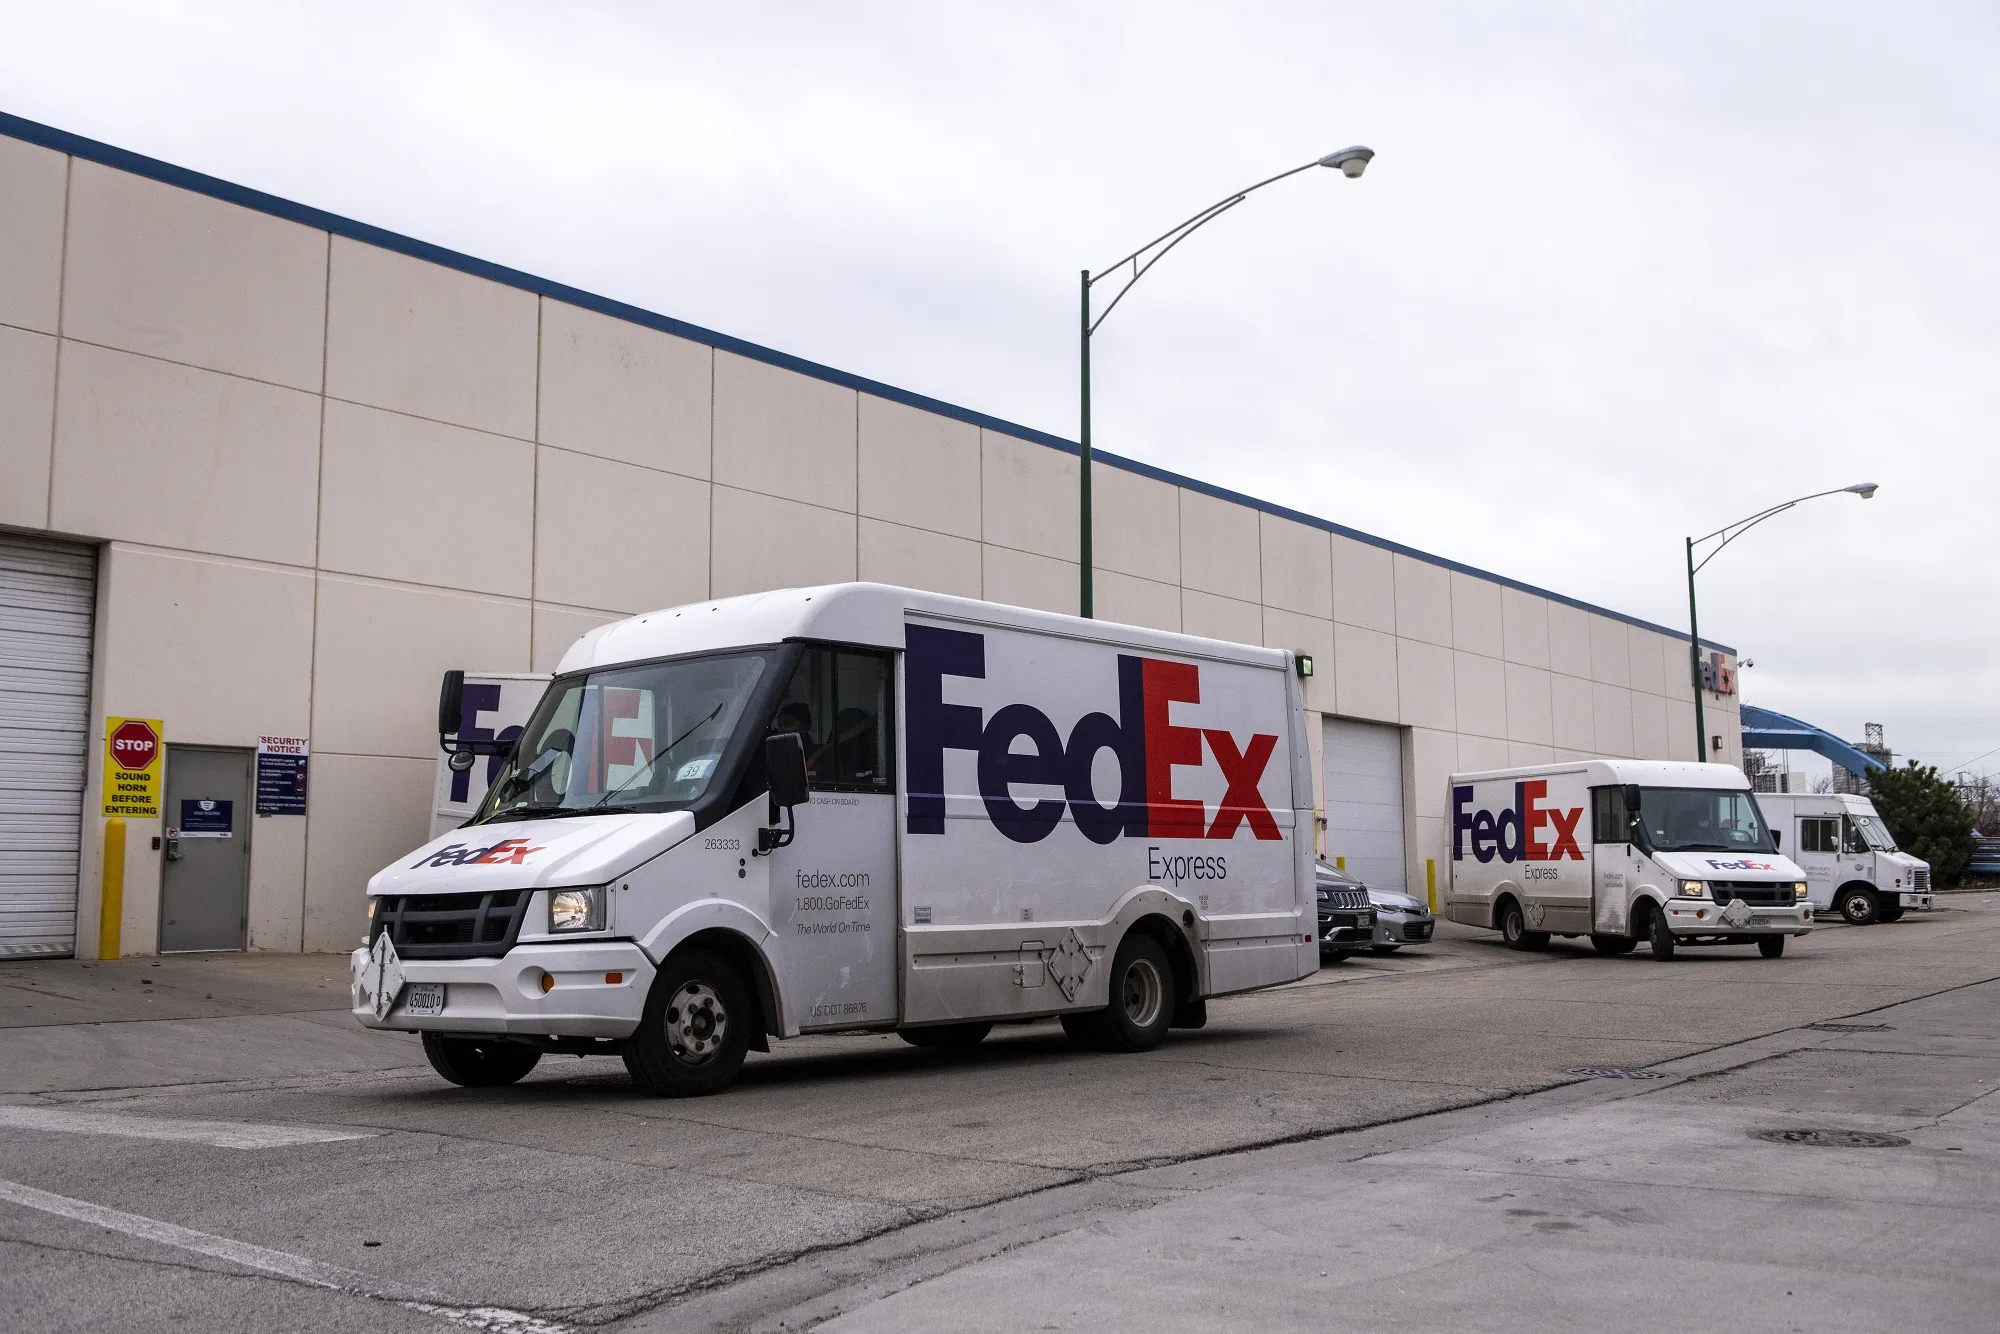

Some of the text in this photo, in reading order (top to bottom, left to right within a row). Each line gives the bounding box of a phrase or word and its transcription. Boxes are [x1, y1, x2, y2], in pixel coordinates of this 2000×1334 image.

[904, 623, 1283, 844] FedEx
[116, 739, 153, 751] STOP
[261, 736, 306, 746] SECURITY
[267, 745, 301, 754] NOTICE
[115, 772, 150, 781] SOUND
[684, 766, 700, 778] 39
[112, 795, 152, 803] BEFORE
[105, 806, 156, 814] ENTERING
[1453, 780, 1584, 864] FedEx
[704, 838, 740, 850] 263333
[410, 838, 547, 870] FedEx
[1148, 847, 1226, 887] Express
[1705, 860, 1778, 871] FedEx
[796, 870, 870, 888] fedex.com
[1525, 865, 1558, 882] Express
[796, 896, 870, 910] 1.800.GoFedEx
[796, 922, 870, 934] The World On Time
[811, 1002, 866, 1017] US DOT 86876
